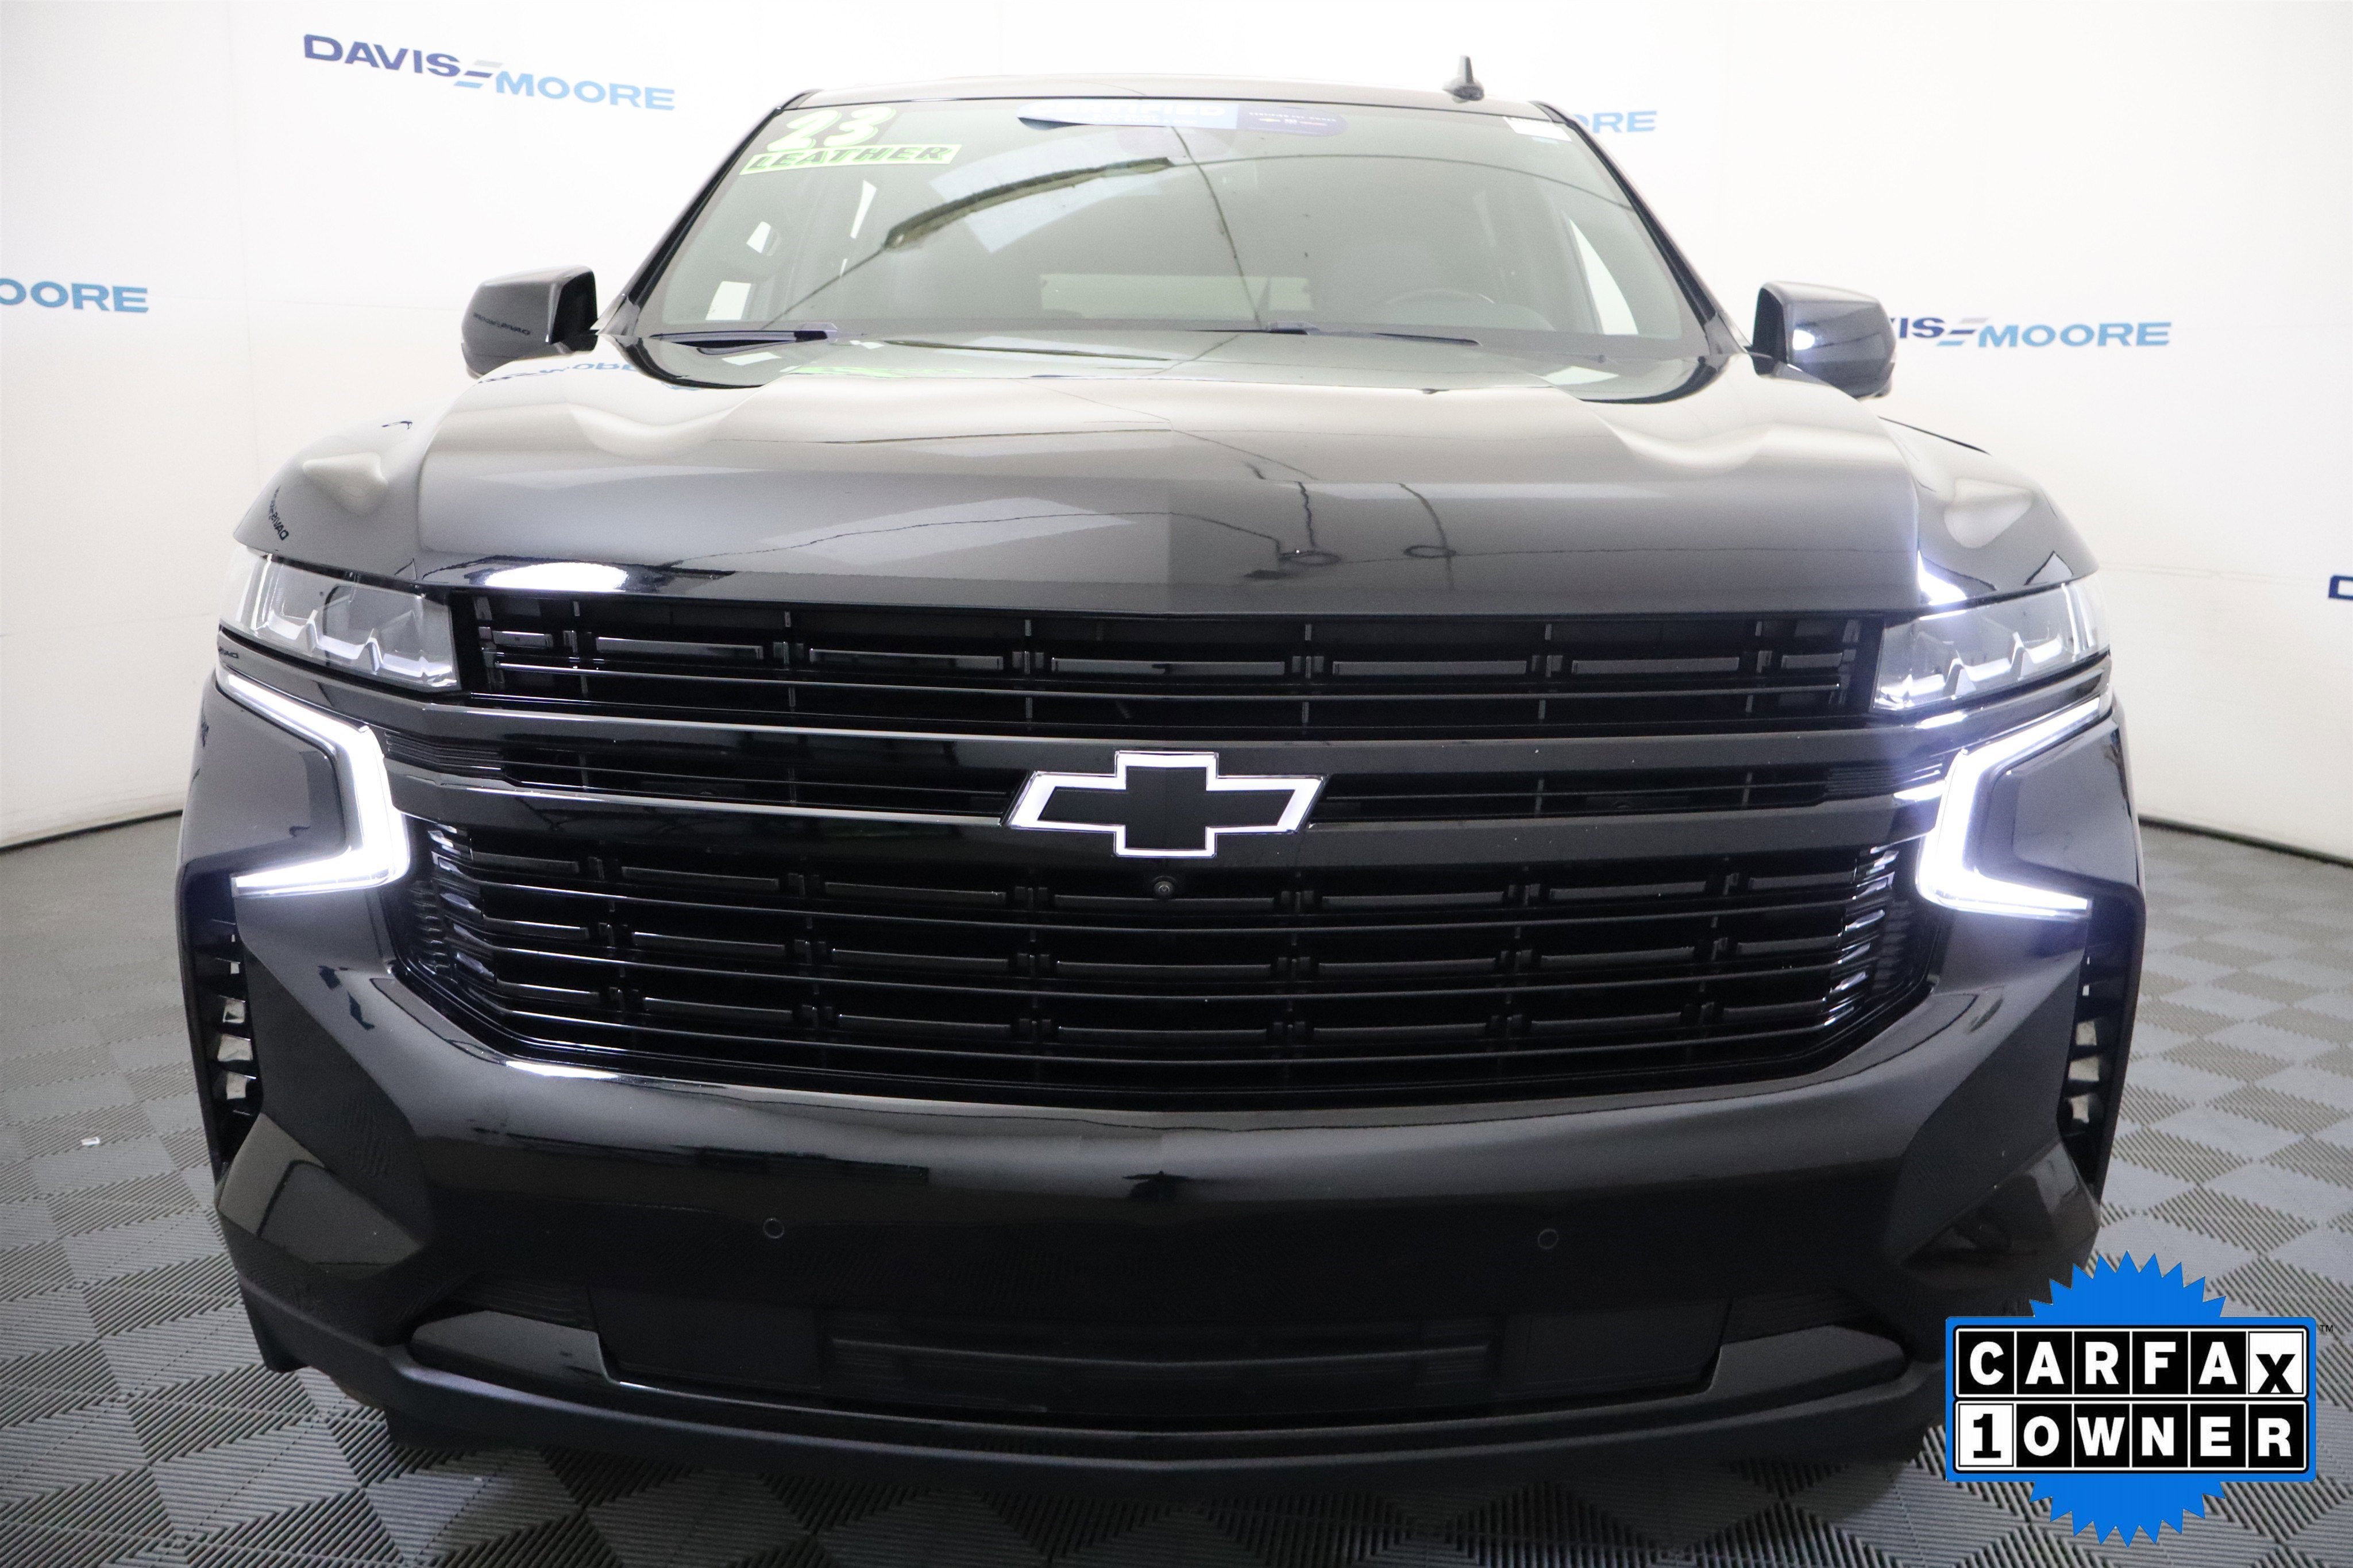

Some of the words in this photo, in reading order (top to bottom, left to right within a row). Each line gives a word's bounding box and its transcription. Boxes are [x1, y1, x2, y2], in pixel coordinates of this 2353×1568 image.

[303, 33, 461, 78] DAVIS
[495, 70, 676, 111] MOORE
[766, 106, 897, 152] 23
[747, 145, 951, 171] LEATHER
[0, 277, 149, 314] OORE
[1891, 317, 1945, 339] IS
[1978, 322, 2172, 348] MOORE
